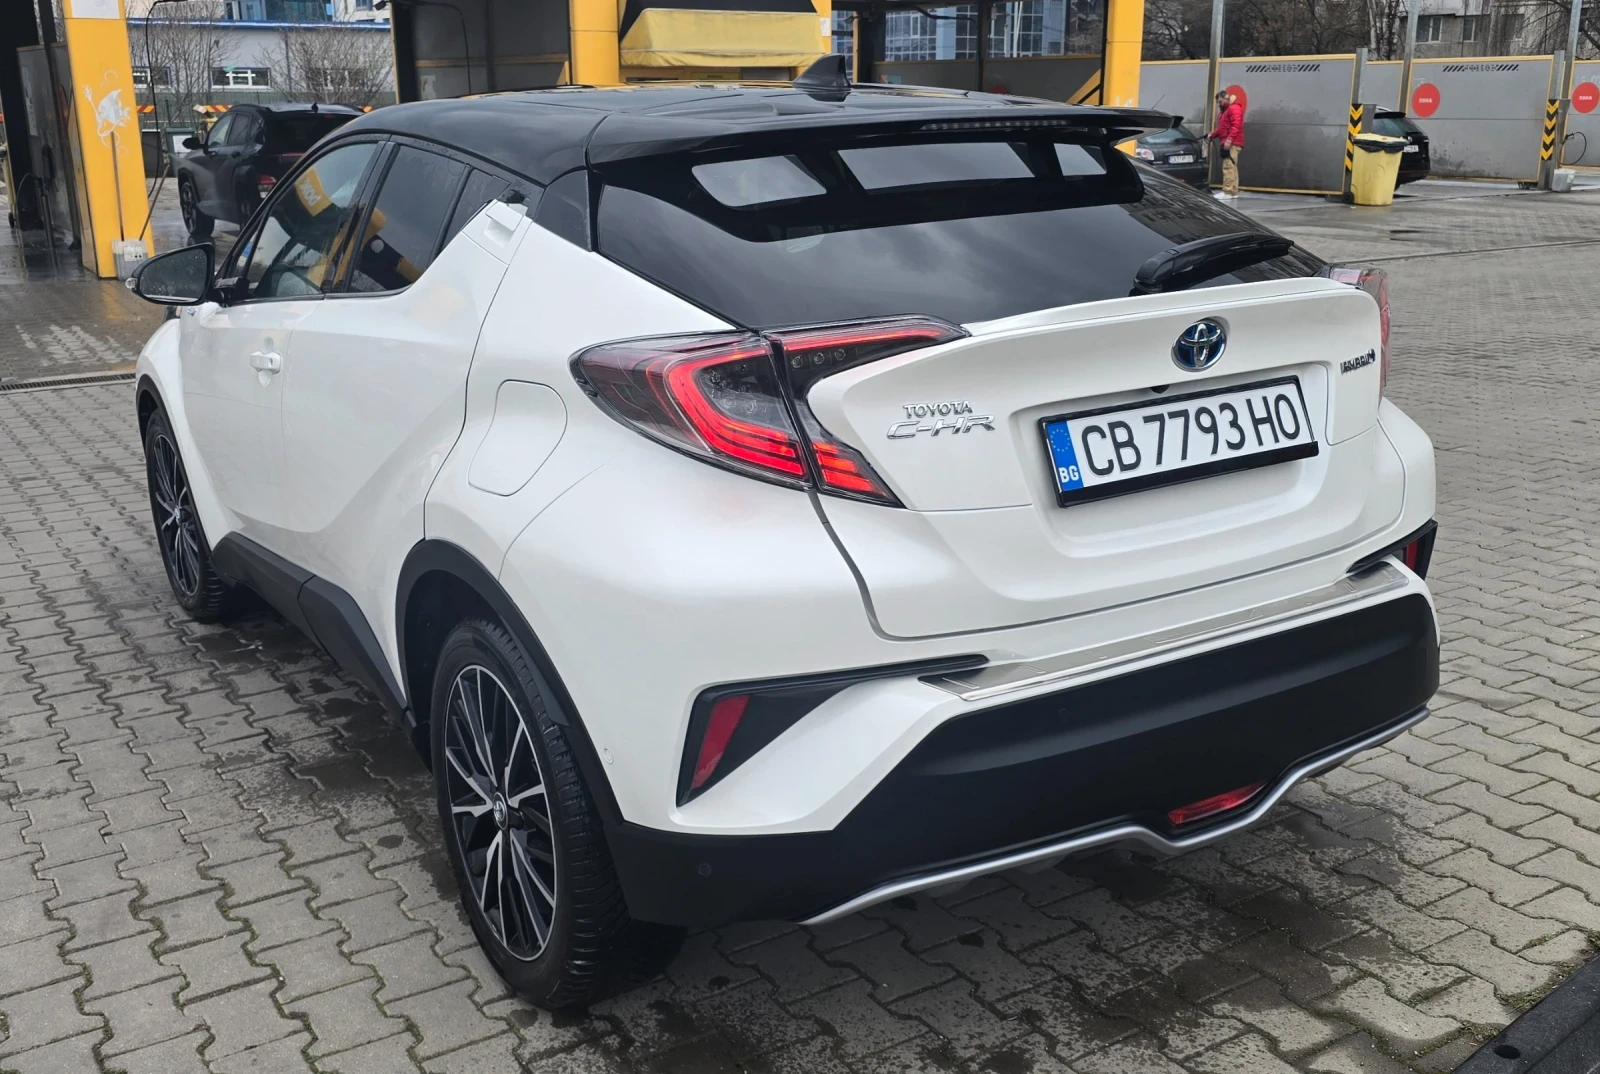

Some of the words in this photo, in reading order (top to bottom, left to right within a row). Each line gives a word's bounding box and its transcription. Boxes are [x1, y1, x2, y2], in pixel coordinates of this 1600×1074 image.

[902, 400, 973, 419] TOYOTA
[886, 414, 996, 439] C-HR
[1058, 464, 1080, 484] BG
